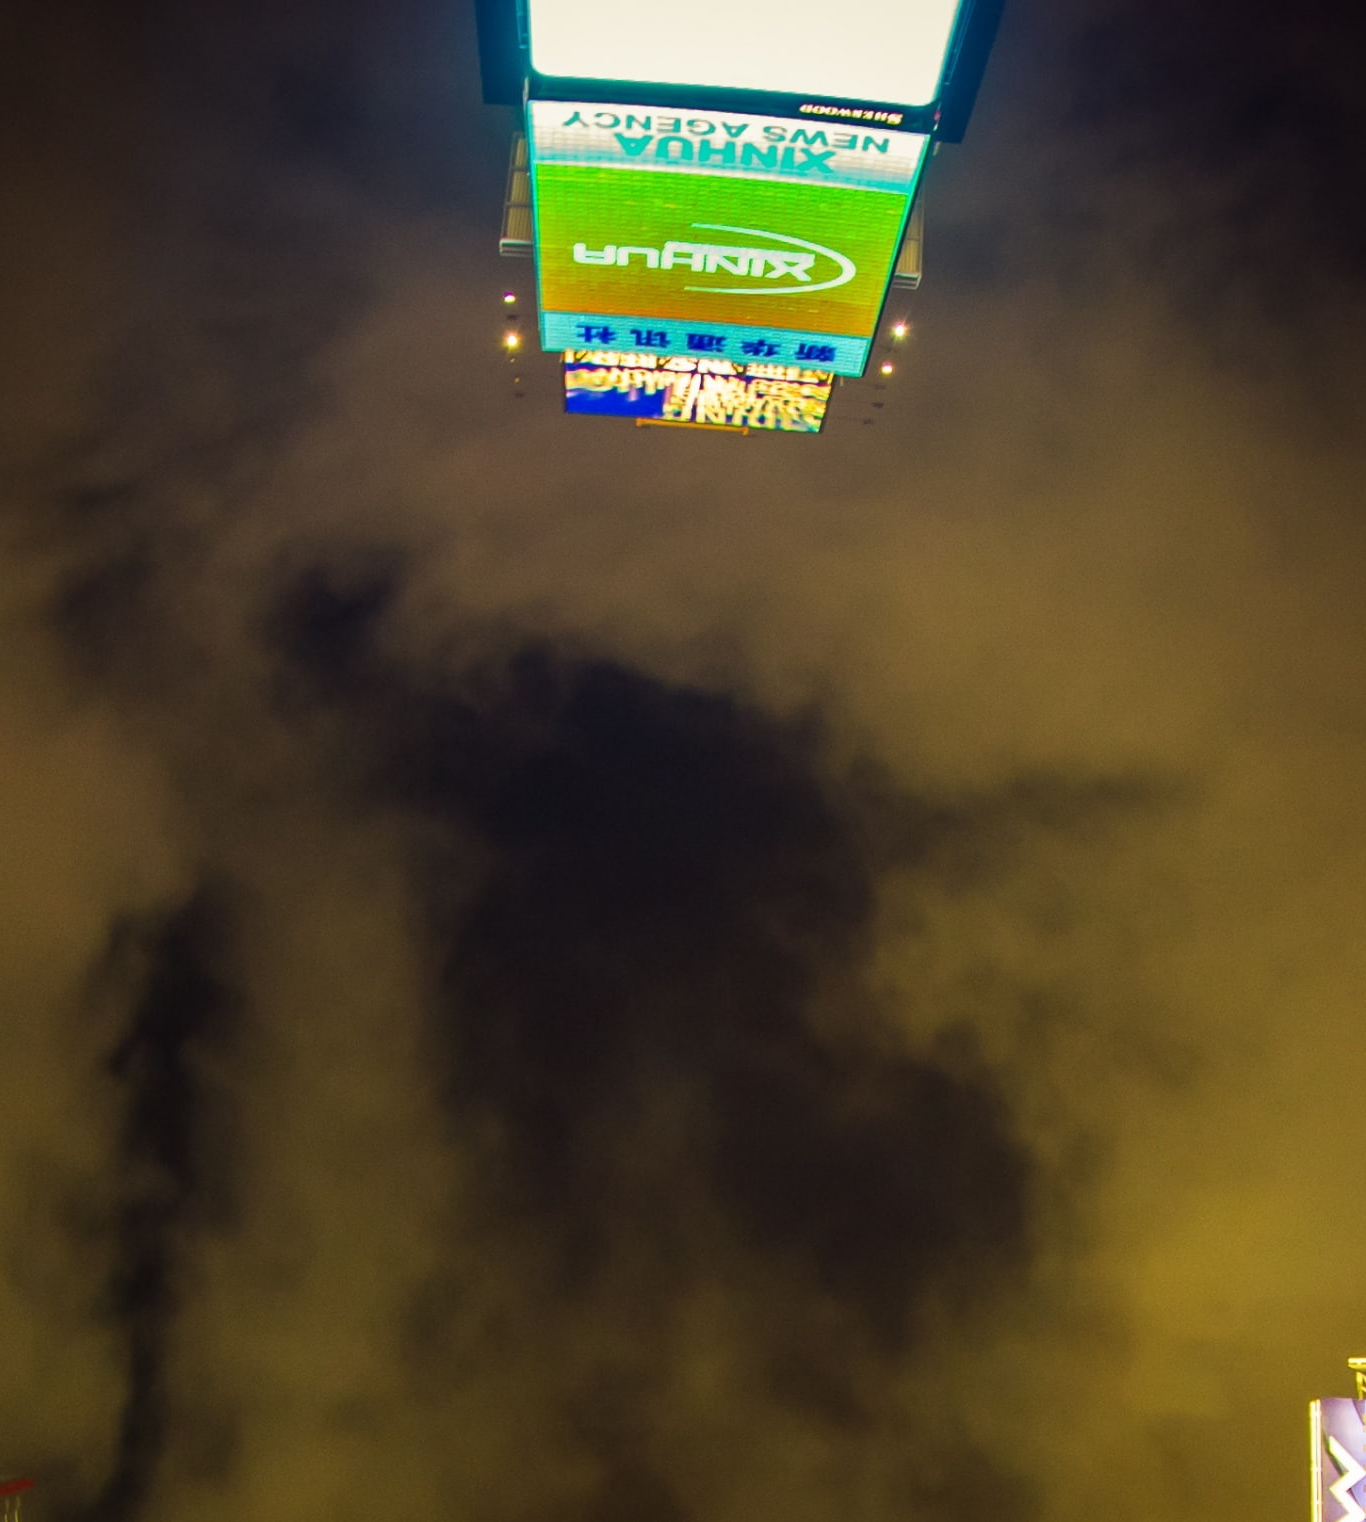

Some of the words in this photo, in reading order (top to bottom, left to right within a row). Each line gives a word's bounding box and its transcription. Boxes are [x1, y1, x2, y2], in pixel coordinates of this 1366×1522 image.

[563, 110, 752, 141] AGENCY
[799, 104, 902, 126] SHERWOOD
[615, 132, 834, 174] XINHUA
[762, 124, 890, 155] NEWS
[577, 322, 837, 363] 新华通讯社
